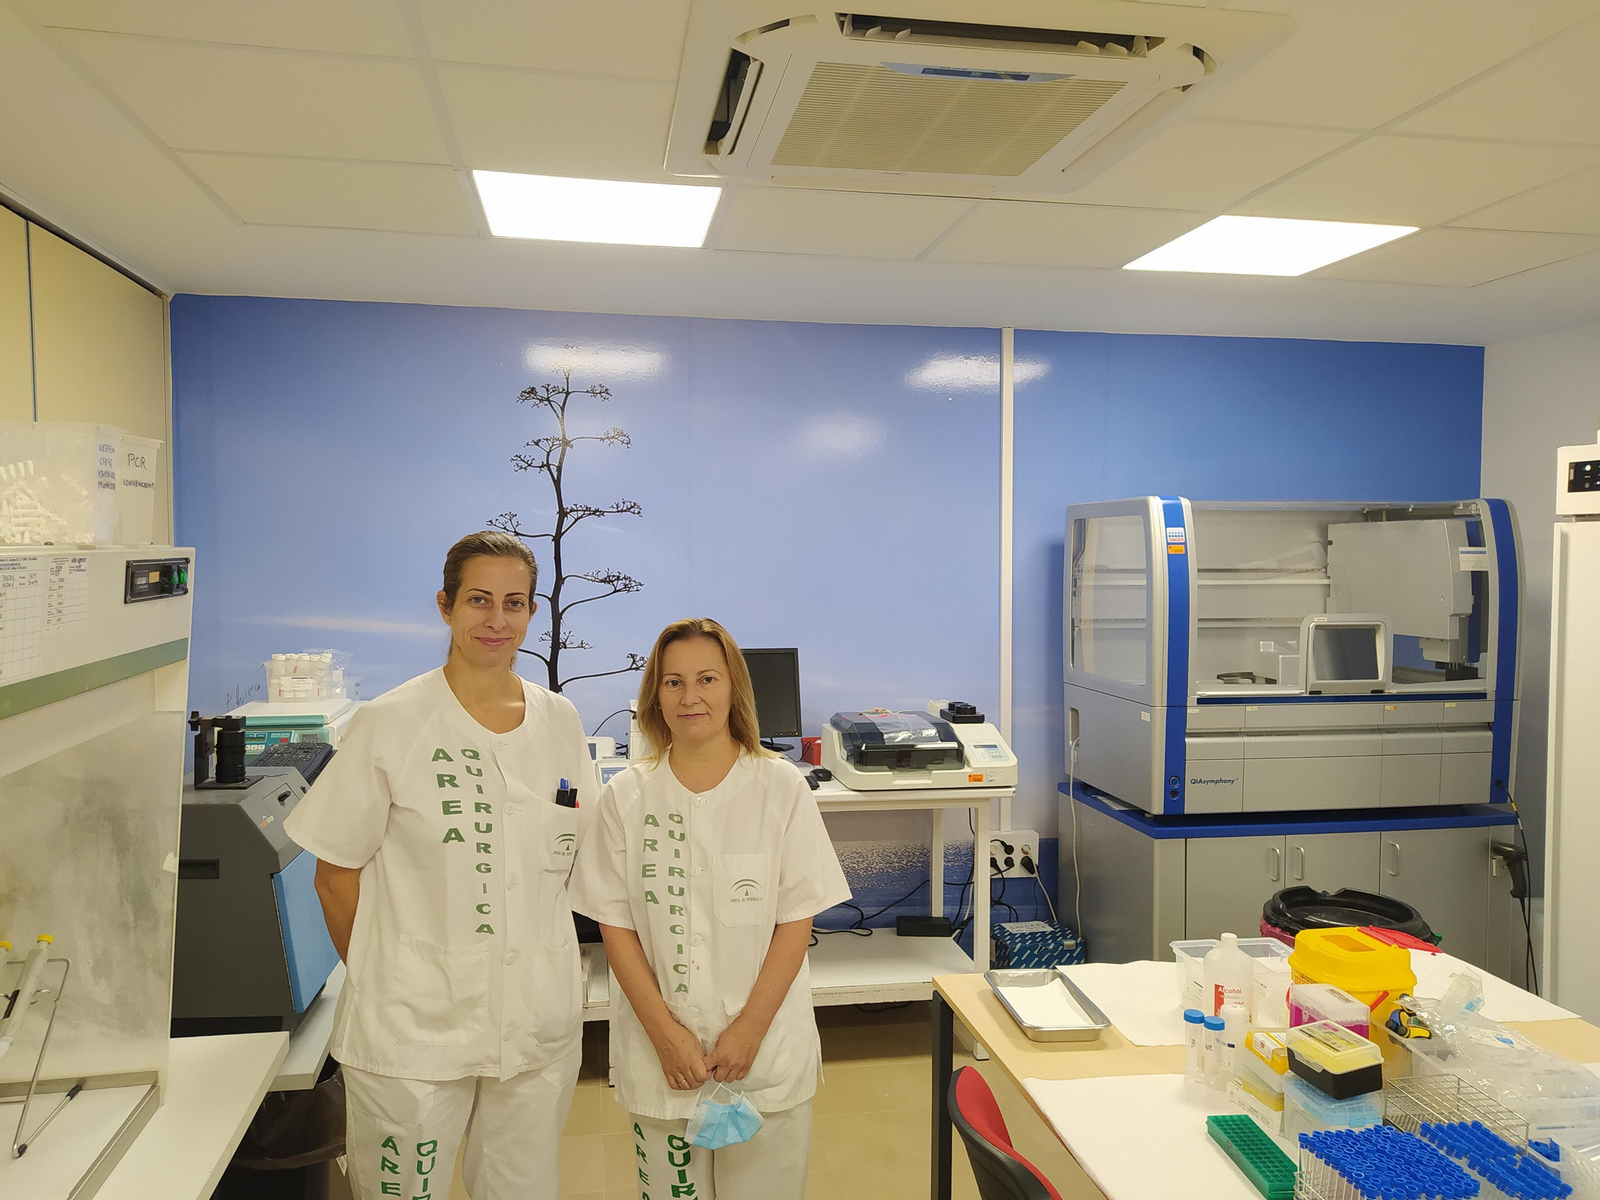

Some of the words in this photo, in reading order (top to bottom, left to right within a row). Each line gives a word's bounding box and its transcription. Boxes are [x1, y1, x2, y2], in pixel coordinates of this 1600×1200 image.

[127, 452, 147, 470] PCR
[431, 747, 466, 844] AREA
[460, 748, 495, 935] QUIRURGICA
[641, 813, 660, 905] AREA
[667, 813, 689, 995] QUIRURGICA
[1217, 986, 1242, 995] Alcohol
